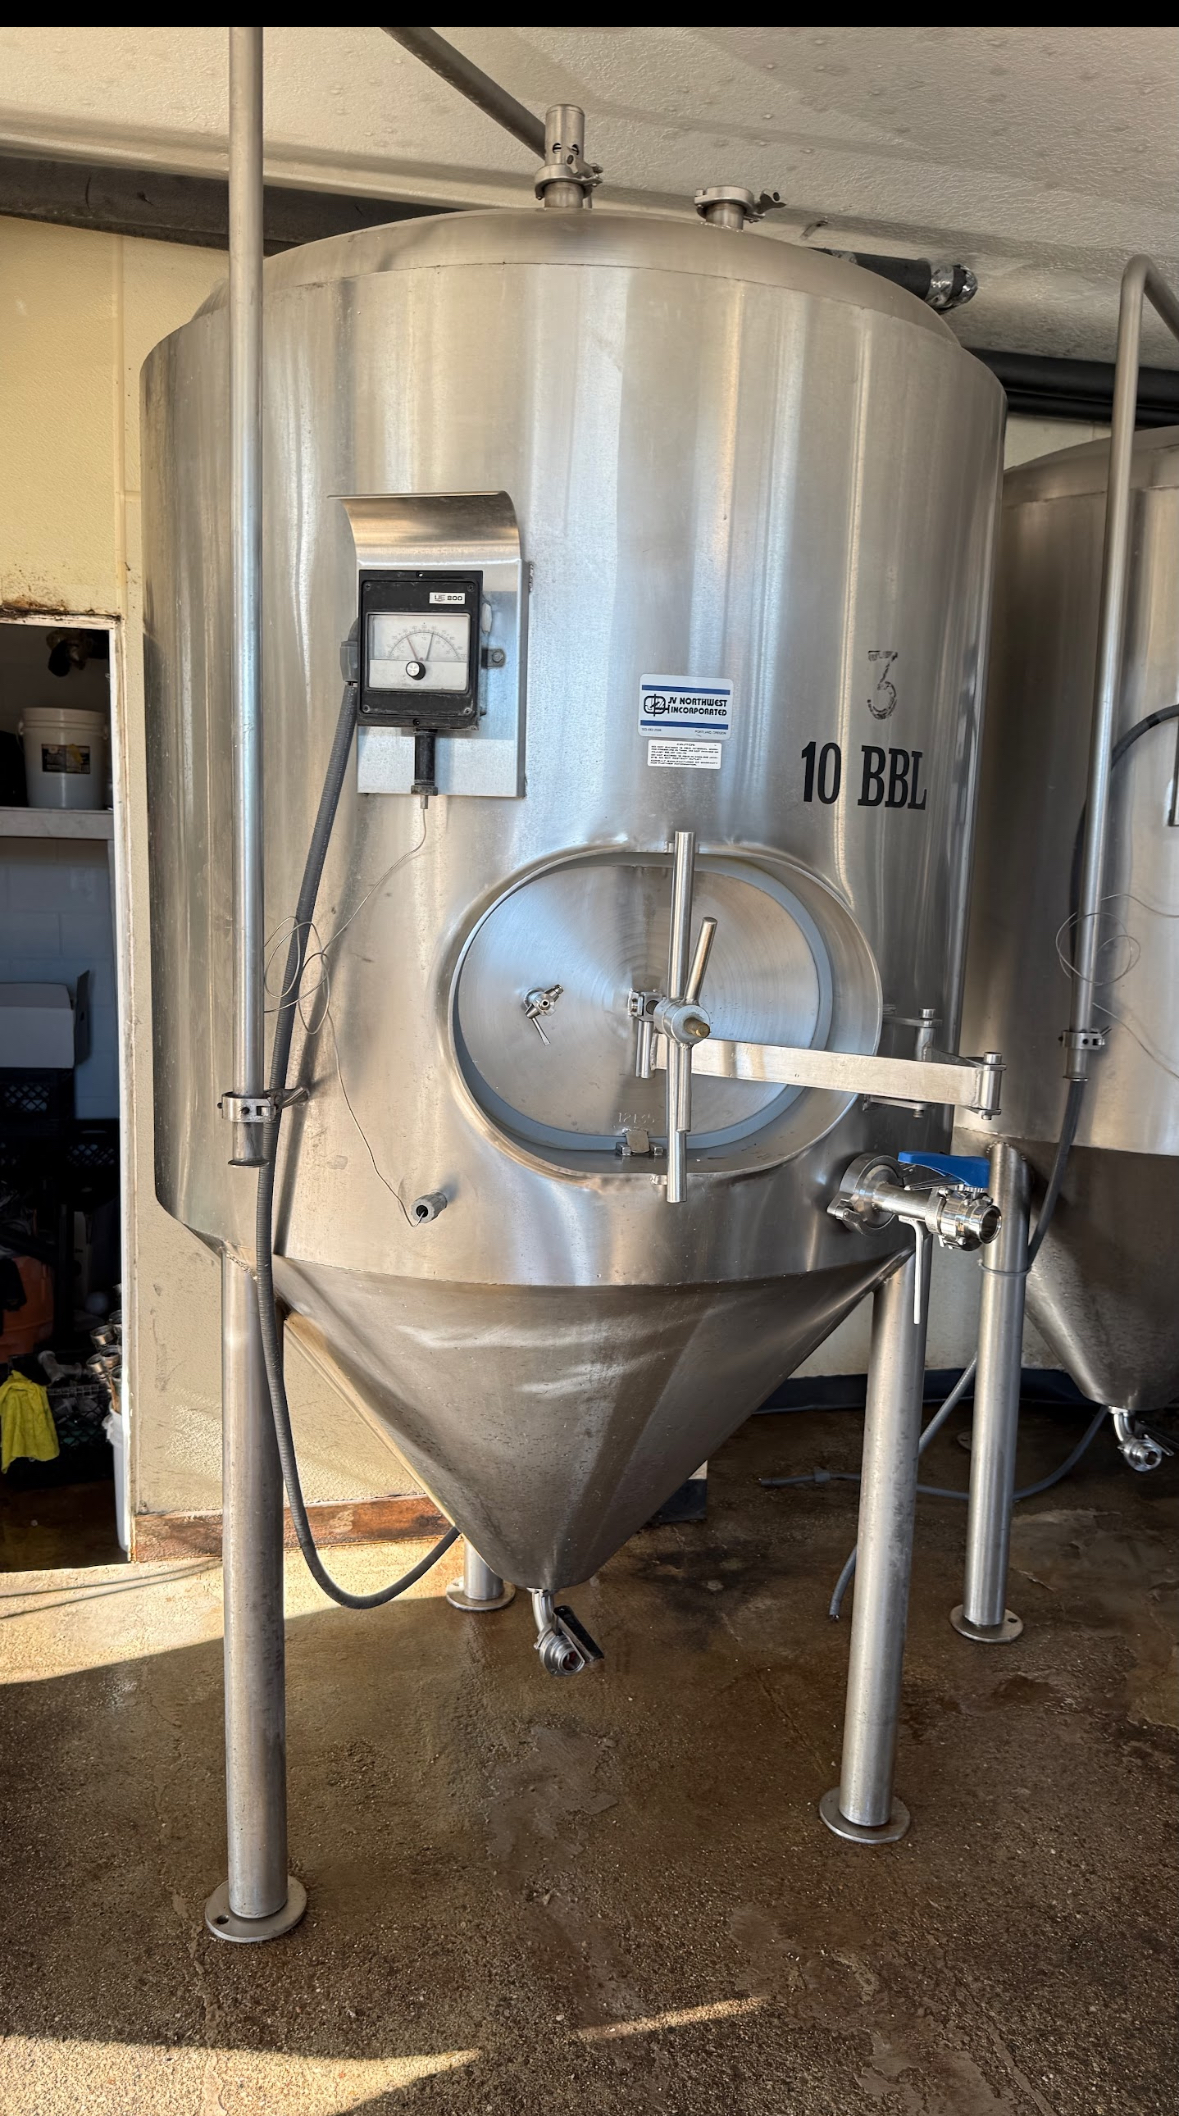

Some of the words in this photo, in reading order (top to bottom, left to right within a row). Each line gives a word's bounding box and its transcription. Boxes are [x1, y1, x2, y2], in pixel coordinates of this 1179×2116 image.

[668, 696, 677, 705] JV
[679, 697, 728, 708] NORTHWEST
[670, 706, 727, 717] INCORPORATED
[801, 741, 842, 805] 10
[857, 744, 928, 811] BBL
